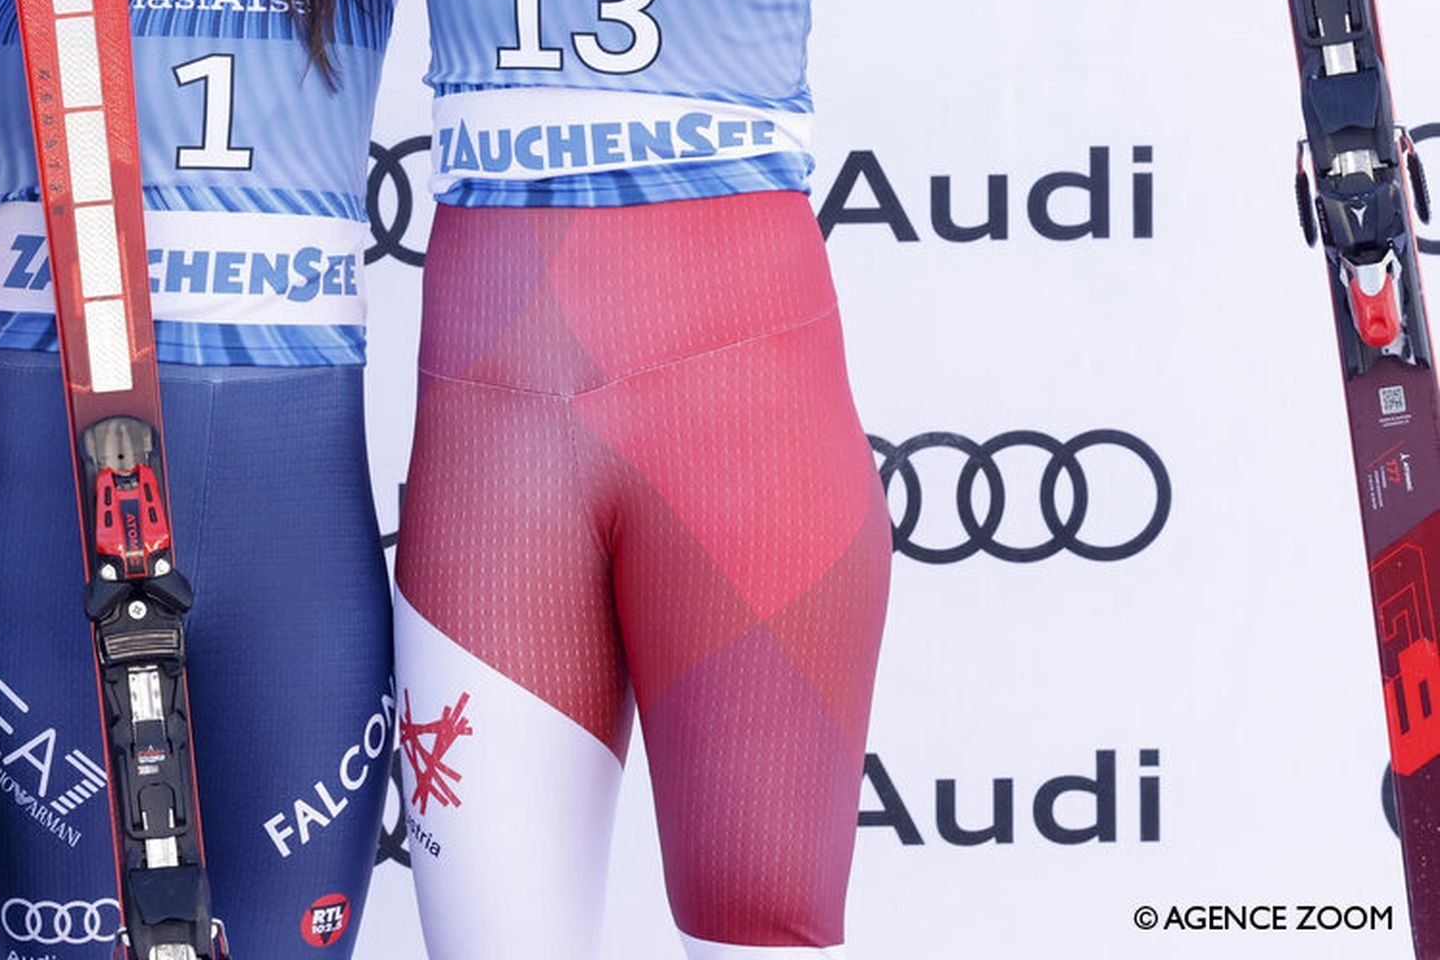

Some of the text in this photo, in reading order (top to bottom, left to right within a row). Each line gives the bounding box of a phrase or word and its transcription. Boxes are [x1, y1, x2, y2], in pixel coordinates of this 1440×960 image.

[172, 52, 253, 171] 1
[816, 145, 1153, 243] Audi
[856, 748, 1160, 846] Audi
[310, 920, 343, 935] 102.5
[311, 905, 343, 925] RTL
